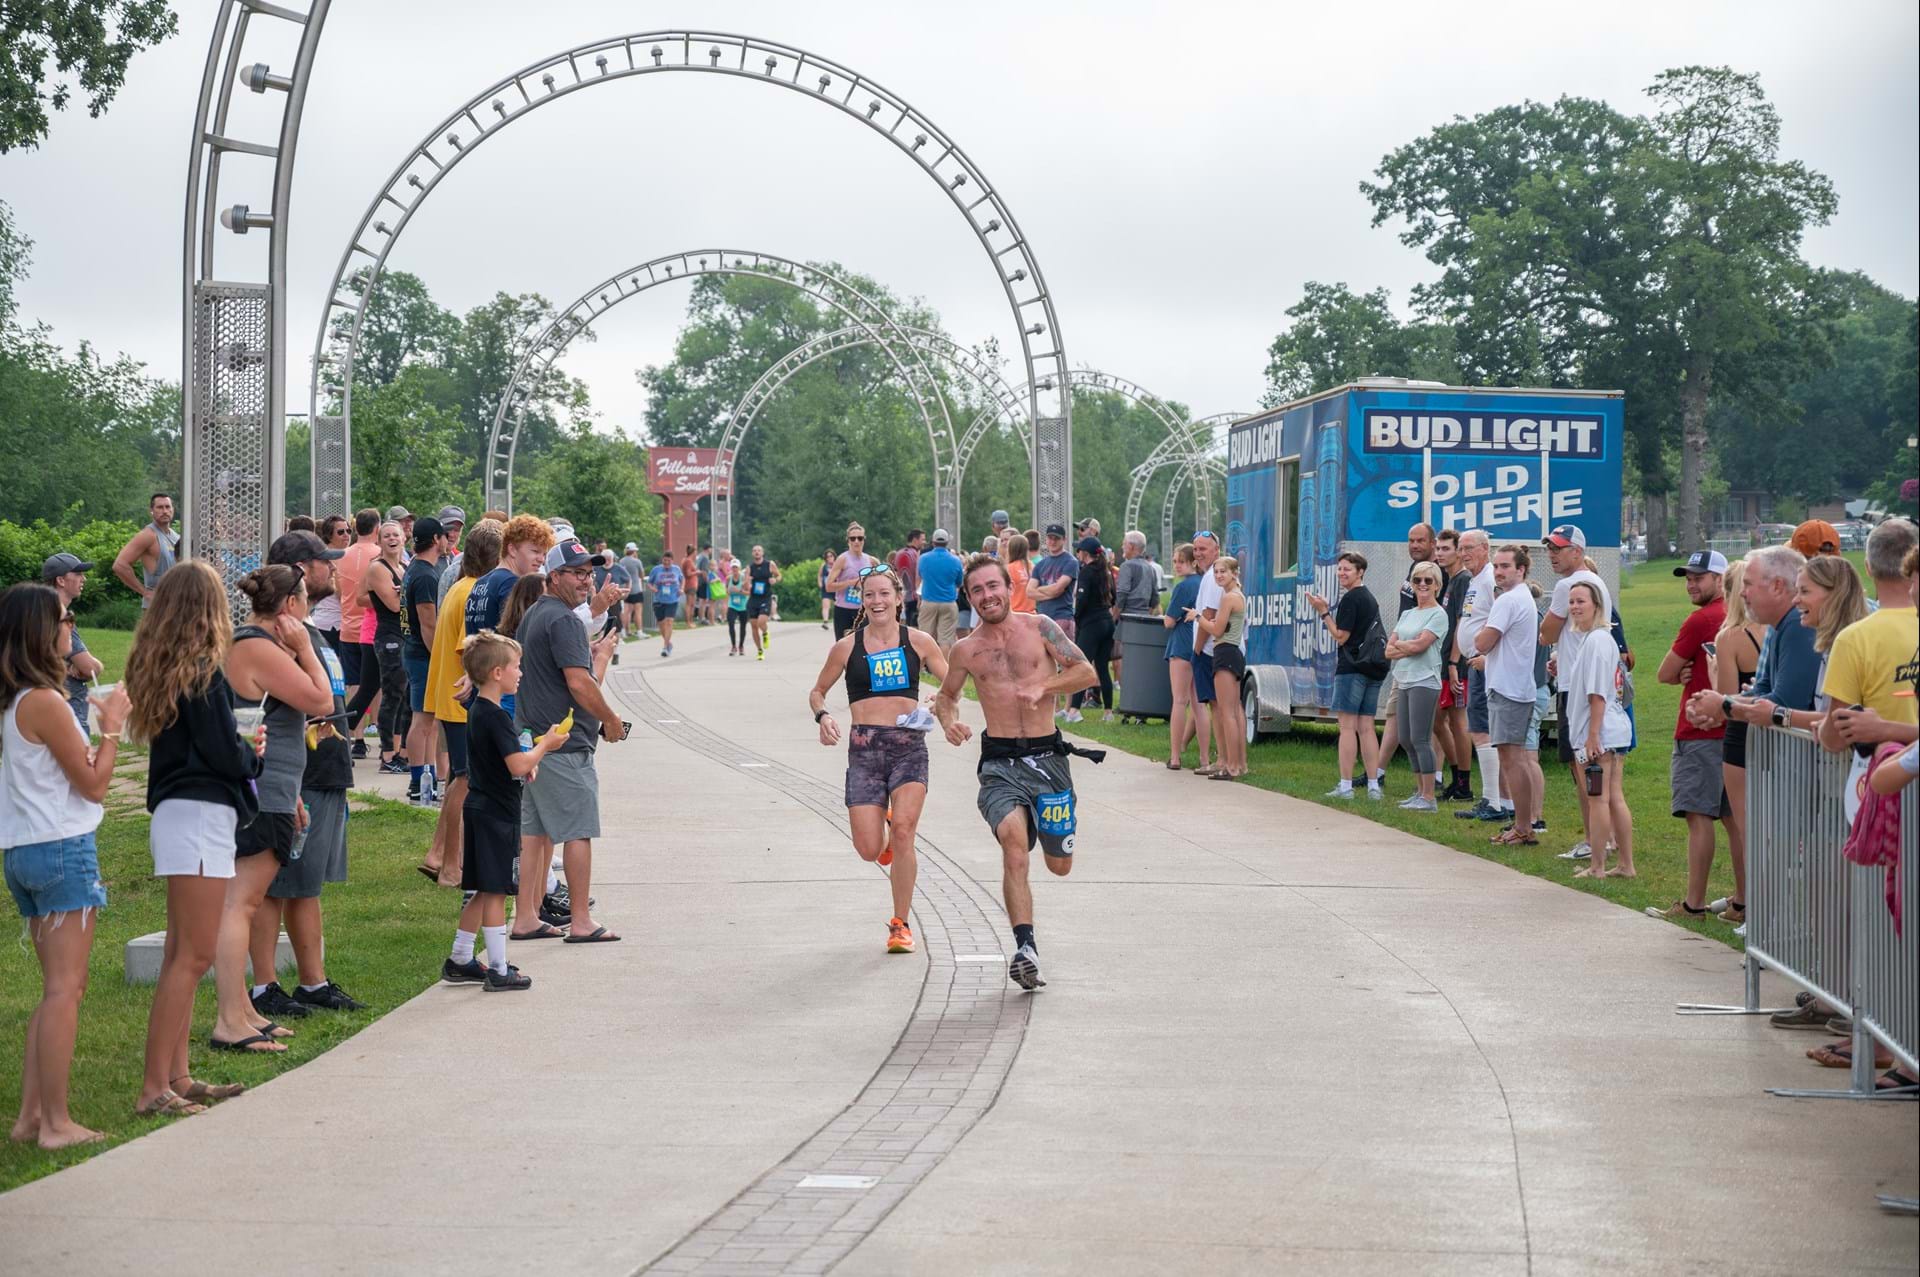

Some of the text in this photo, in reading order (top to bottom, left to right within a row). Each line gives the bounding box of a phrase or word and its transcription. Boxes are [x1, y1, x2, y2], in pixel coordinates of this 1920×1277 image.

[1231, 420, 1283, 469] BUD LIGHT
[1370, 416, 1598, 453] BUD LIGHT
[675, 476, 711, 491] South
[1387, 465, 1529, 509] SOLD
[1442, 488, 1583, 531] HERE
[1246, 593, 1292, 627] OLD HERE
[874, 659, 903, 677] 482
[1041, 804, 1070, 822] 404
